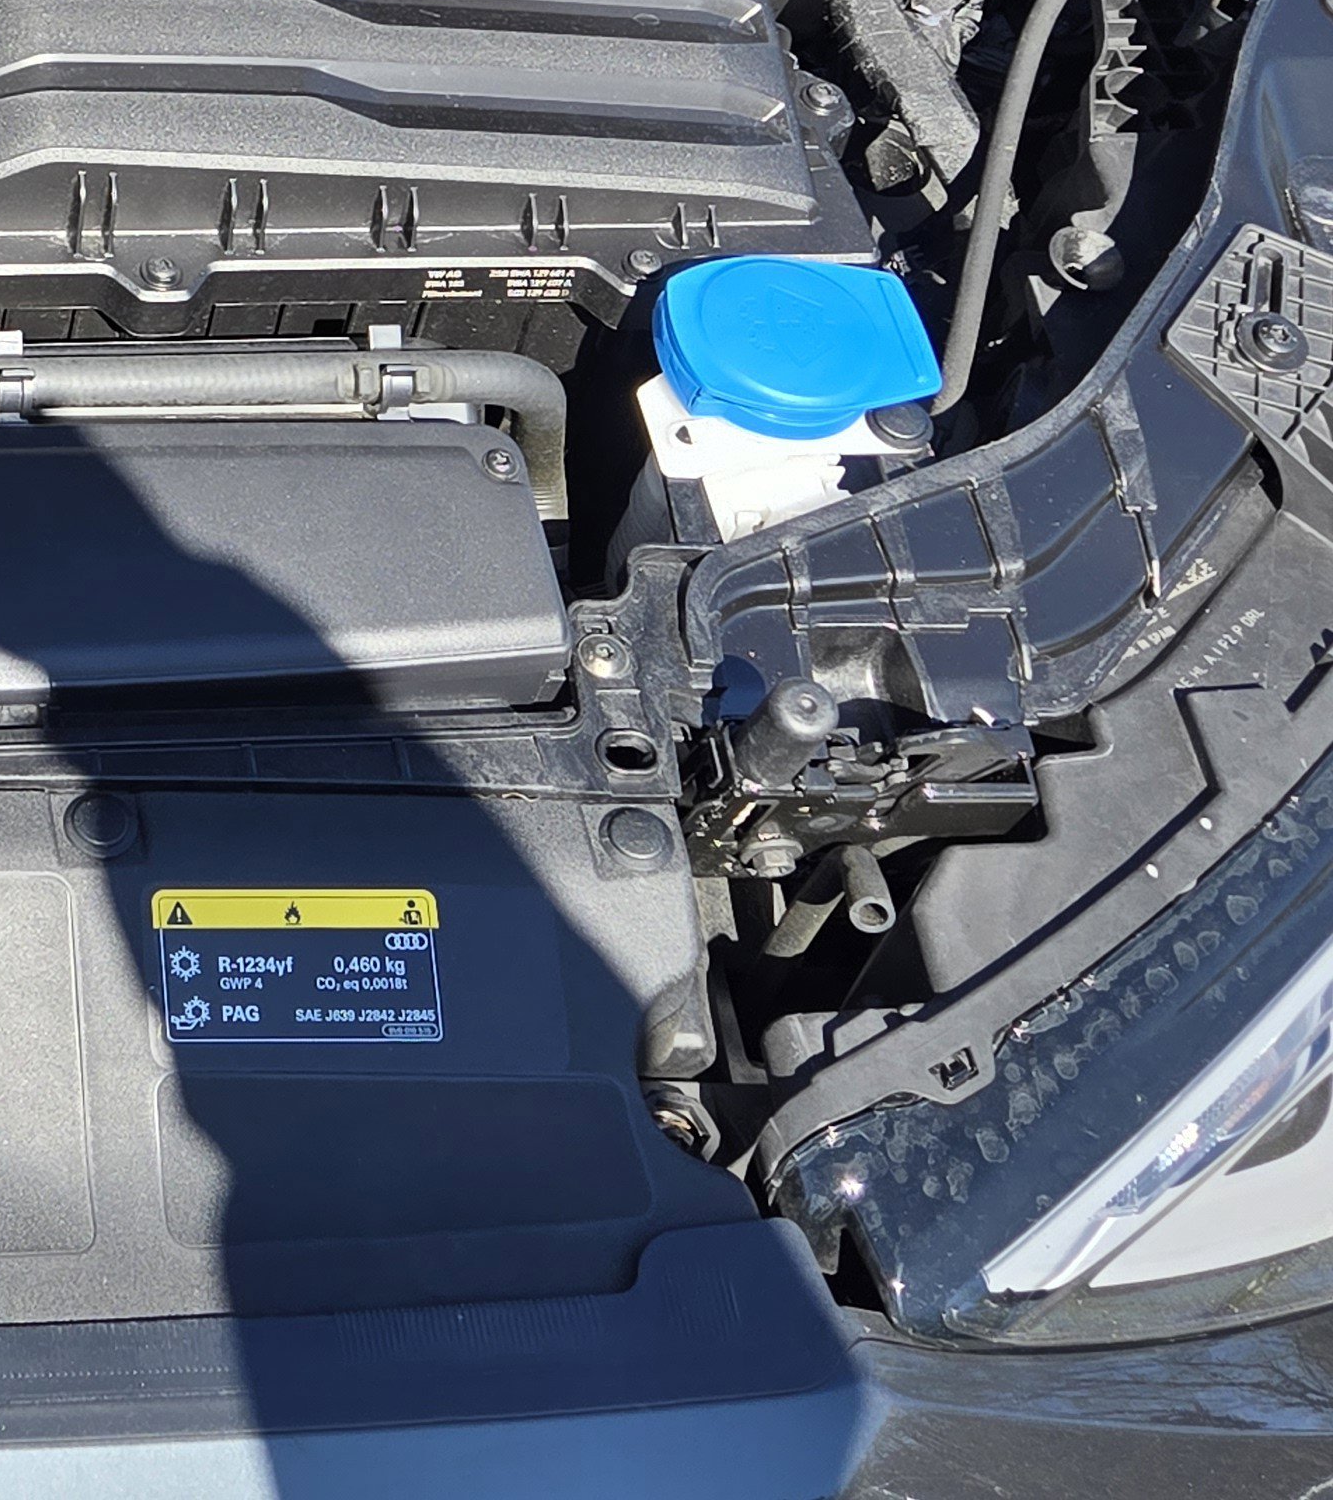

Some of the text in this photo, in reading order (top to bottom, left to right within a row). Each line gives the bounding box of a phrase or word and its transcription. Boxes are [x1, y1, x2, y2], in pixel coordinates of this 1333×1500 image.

[218, 957, 406, 977] R-1234yf 0,460 kg
[220, 978, 253, 990] GWP
[254, 978, 263, 989] 4
[343, 979, 360, 993] eq
[222, 1006, 436, 1022] PAG SAE J639 J2842 J2845
